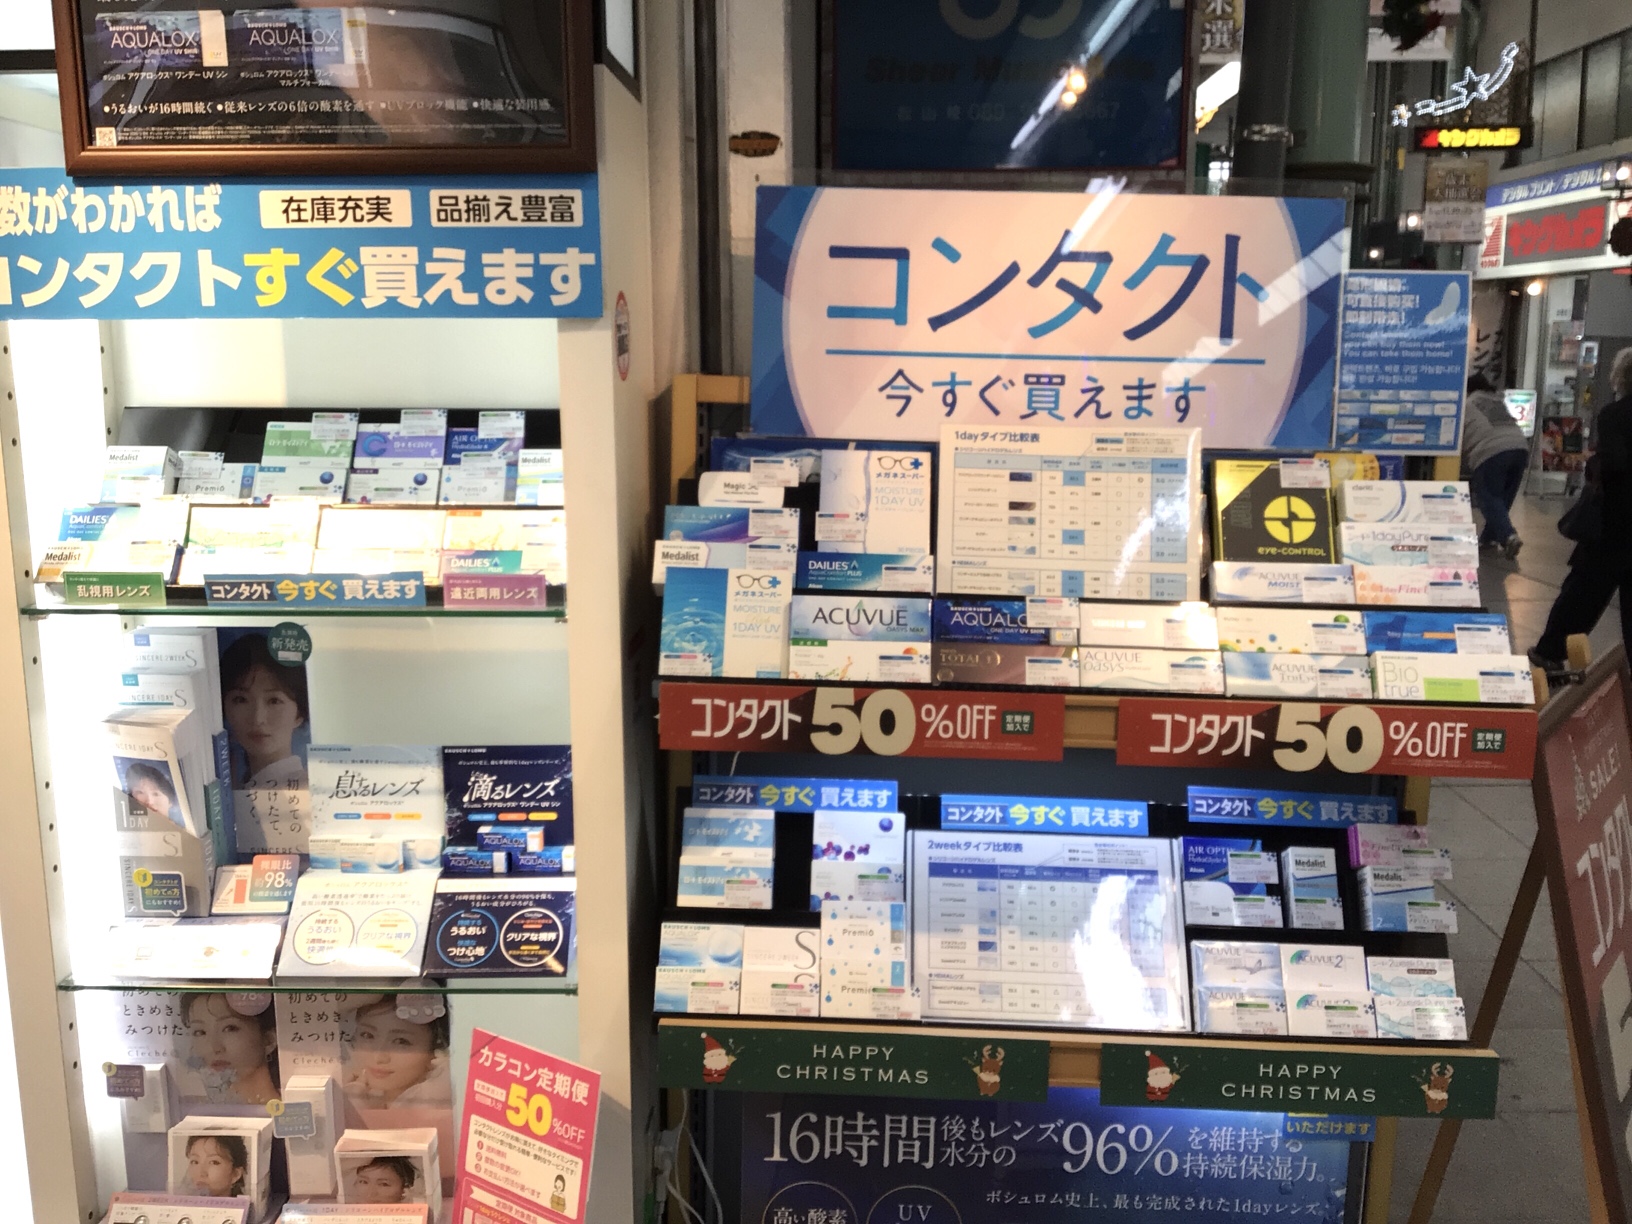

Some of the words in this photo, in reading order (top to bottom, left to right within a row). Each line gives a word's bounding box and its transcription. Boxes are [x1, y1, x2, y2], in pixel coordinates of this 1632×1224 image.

[111, 32, 198, 49] AQUALOX
[249, 29, 338, 47] AQUALOX
[215, 71, 228, 79] シン
[279, 79, 331, 87] マルチフォーカル
[282, 195, 392, 223] 在庫充実
[437, 195, 575, 223] 品揃え豊富
[0, 246, 596, 309] ンタクトすぐ買えます
[826, 229, 1270, 346] コンタクト
[878, 369, 1207, 423] 今すぐ買えます
[954, 430, 1041, 443] 1dayタイプ比較表
[109, 454, 139, 462] Medalist
[876, 472, 924, 480] メガネスーパー
[875, 487, 924, 495] MOISTURE
[875, 496, 907, 506] 1DAY
[909, 497, 925, 507] UV
[70, 515, 107, 524] DAILIES
[45, 553, 81, 562] Medalist
[661, 551, 699, 561] Medalist
[450, 558, 491, 568] DAILIES
[808, 560, 849, 570] DAILIES
[77, 585, 151, 597] 乱視用レンズ
[211, 580, 271, 601] コンタクト
[277, 580, 337, 602] 今すぐ
[342, 579, 421, 601] 買えます
[1267, 581, 1301, 589] MOIST
[450, 587, 539, 600] 遠近両用レンズ
[733, 604, 781, 614] MOISTURE
[812, 607, 909, 627] ACUVUE
[733, 623, 761, 633] 1DAY
[764, 624, 781, 633] UV
[271, 636, 310, 652] 新発売
[1084, 651, 1142, 663] ACUVUE
[691, 698, 802, 741] コンタクト
[809, 686, 916, 756] 50
[1149, 711, 1265, 758] コンタクト
[1273, 703, 1385, 774] 50
[463, 773, 561, 803] 滴るレンズ
[699, 786, 754, 805] コンタクト
[760, 784, 816, 806] 今すぐ
[821, 787, 892, 807] 買えます
[947, 805, 1003, 823] コンタクト
[1009, 803, 1064, 826] 今すぐ
[1071, 807, 1142, 828] 買えます
[1195, 798, 1251, 817] コンタクト
[1258, 797, 1314, 820] 今すぐ
[1320, 801, 1392, 823] 買えます
[484, 837, 525, 846] AQUALOX
[927, 840, 1023, 853] 2weekタイプ比較表
[450, 858, 492, 868] AQUALOX
[519, 857, 561, 867] AQUALOX
[1295, 859, 1326, 868] Medalist
[307, 925, 342, 934] うるおい
[450, 926, 486, 936] うるおい
[812, 1044, 895, 1061] HAPPY
[478, 1046, 590, 1106] カラコン定期便
[776, 1064, 929, 1085] CHRISTMAS
[1259, 1063, 1342, 1080] HAPPY
[1221, 1083, 1377, 1103] CHRISTMAS
[506, 1083, 552, 1136] 50
[763, 1111, 938, 1170] 16時間
[941, 1115, 1064, 1143] 後もレンズ
[1062, 1121, 1180, 1177] 96%
[940, 1143, 1017, 1168] 水分の
[897, 1204, 933, 1222] UV
